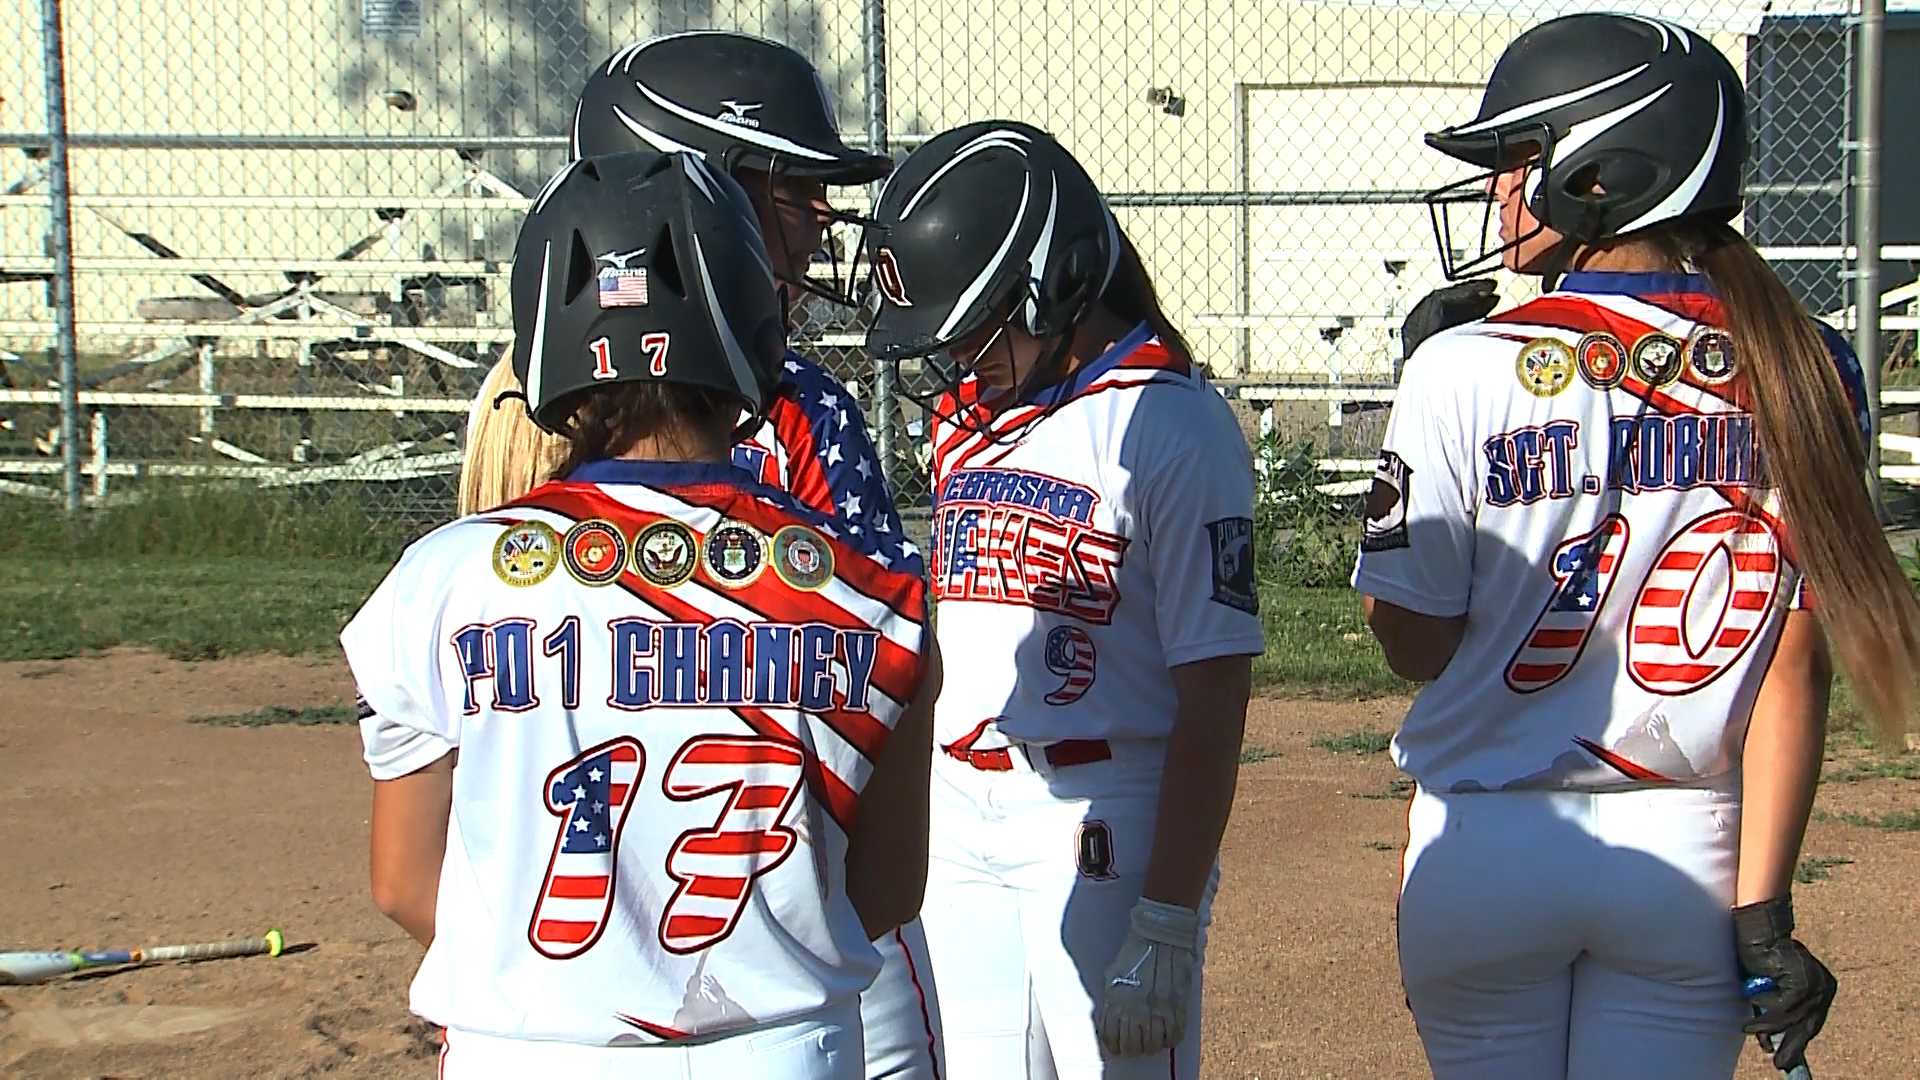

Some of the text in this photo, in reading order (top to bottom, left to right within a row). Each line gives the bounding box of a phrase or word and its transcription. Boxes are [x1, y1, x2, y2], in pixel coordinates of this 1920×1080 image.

[938, 467, 1101, 529] EBRASKA
[1481, 411, 1772, 508] SGT. ROBIN
[1503, 506, 1783, 697] 10
[607, 616, 883, 714] CHANEY
[1043, 624, 1097, 706] 9
[528, 733, 805, 960] 17
